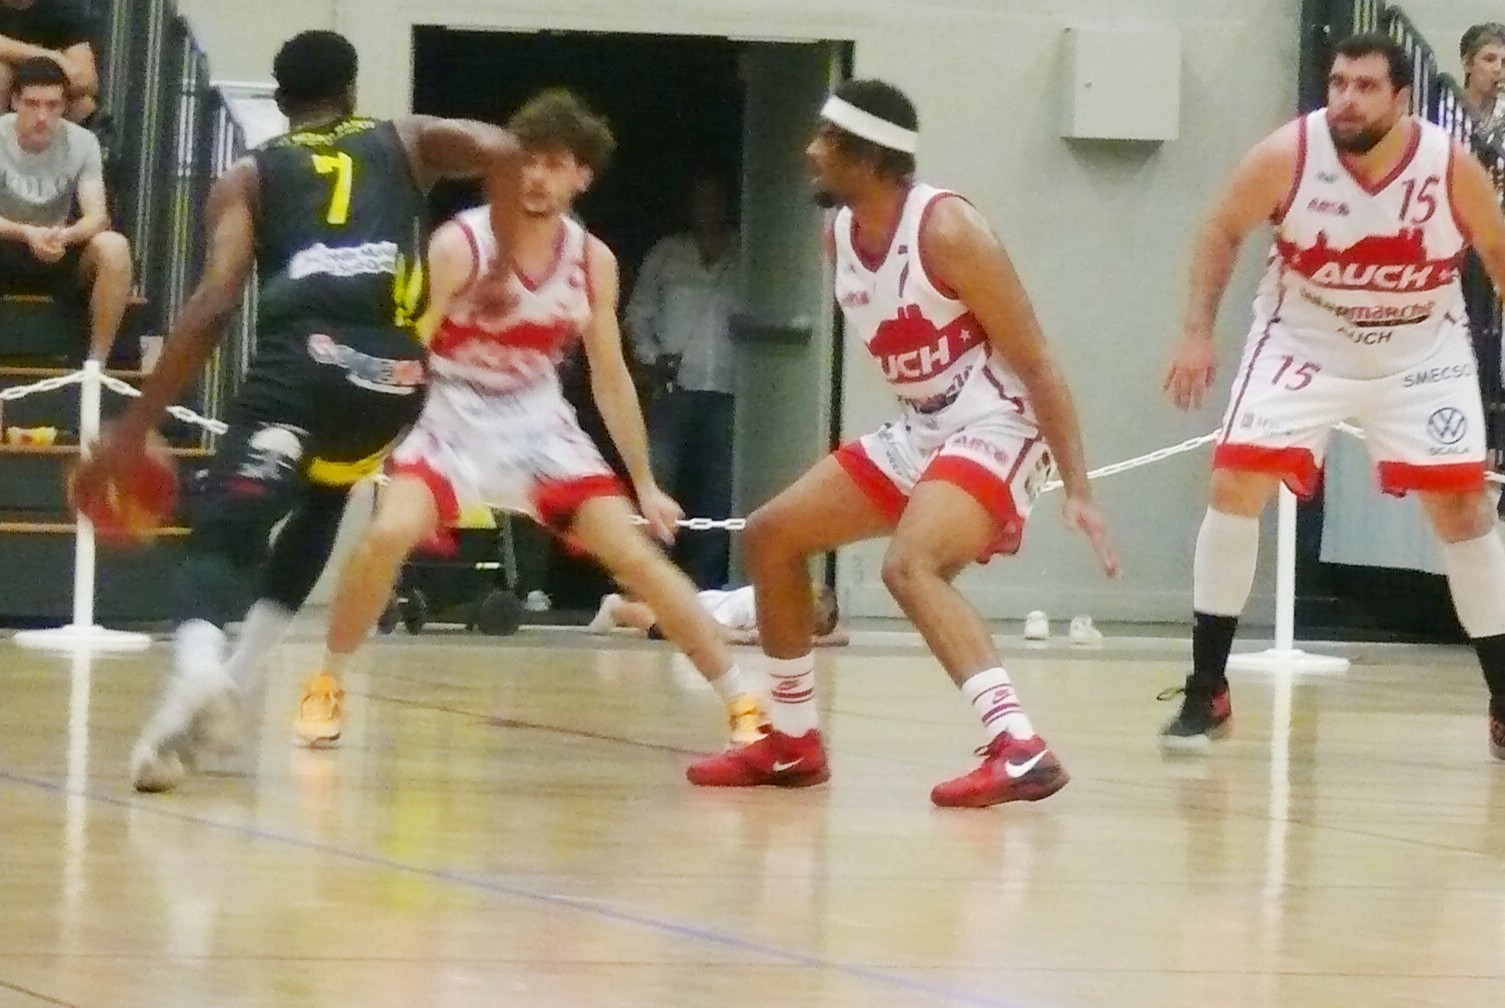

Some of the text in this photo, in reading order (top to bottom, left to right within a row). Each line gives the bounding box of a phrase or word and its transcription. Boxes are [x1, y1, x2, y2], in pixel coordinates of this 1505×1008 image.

[312, 152, 354, 226] 7
[1399, 175, 1440, 224] 15
[1311, 262, 1434, 289] AUCH
[879, 336, 951, 380] UCH
[1270, 355, 1322, 392] 15
